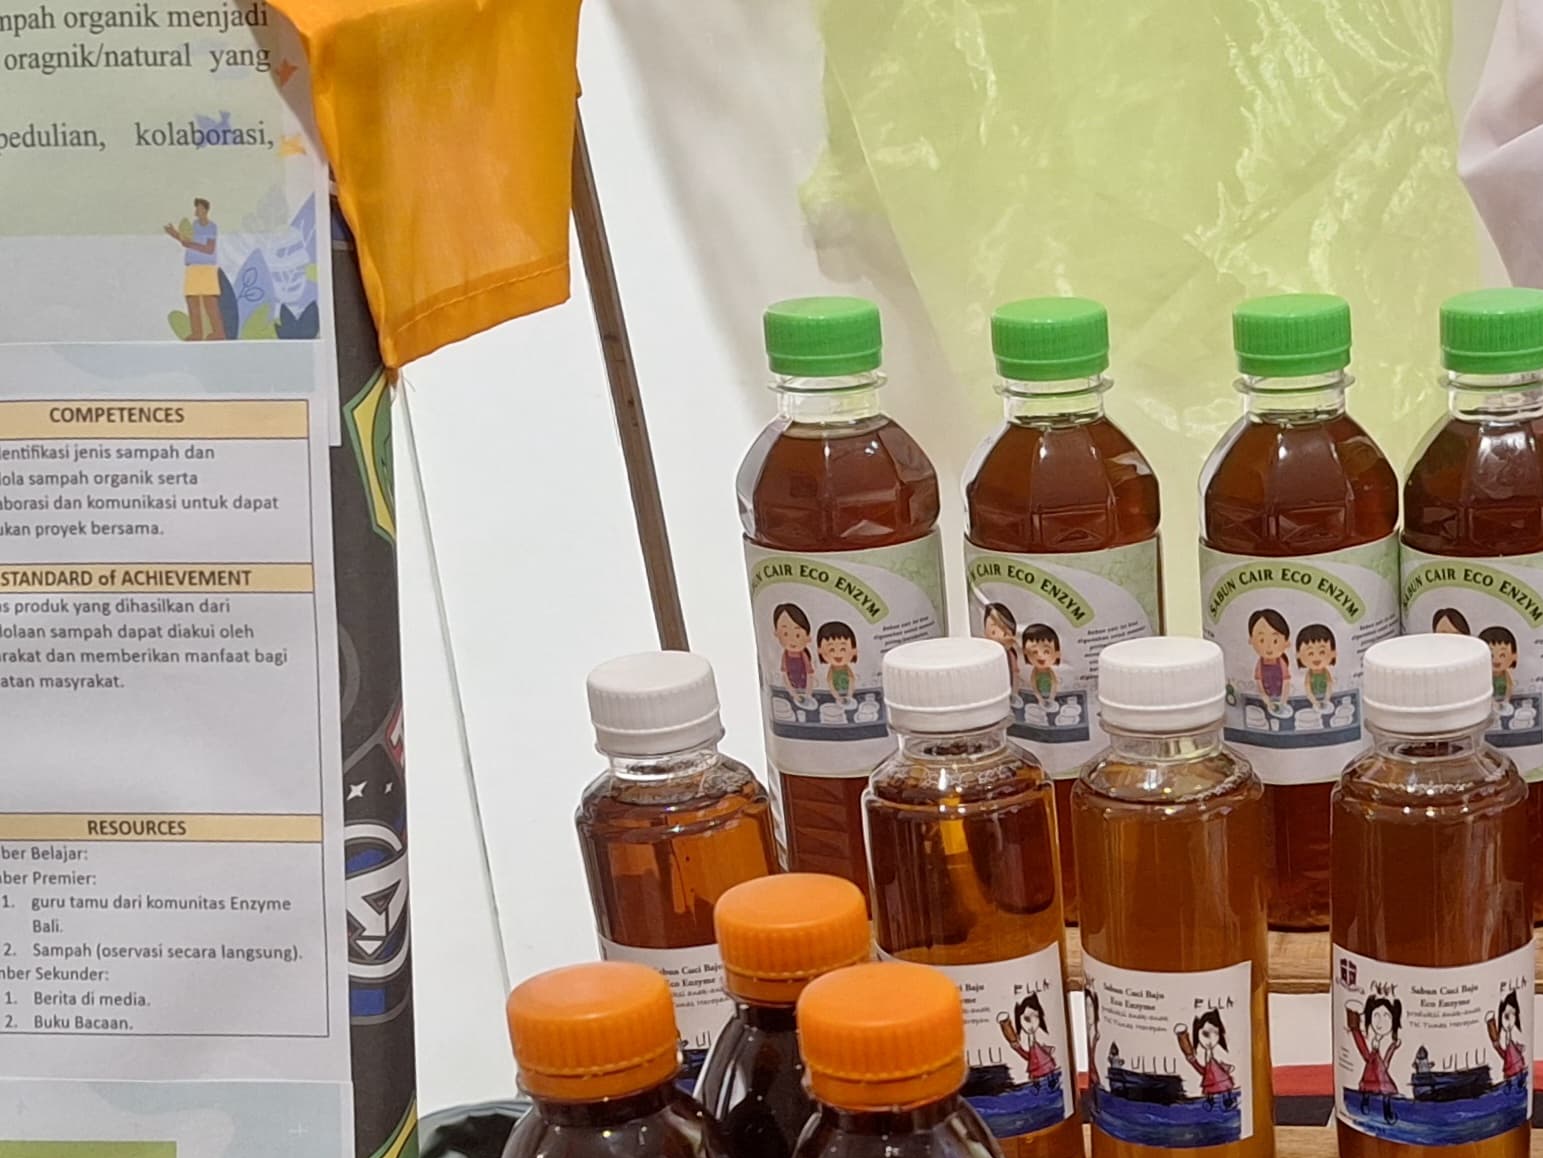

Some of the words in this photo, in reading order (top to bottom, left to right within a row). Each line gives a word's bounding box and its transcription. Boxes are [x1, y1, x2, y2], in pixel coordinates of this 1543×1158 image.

[64, 4, 160, 34] organik
[167, 2, 269, 33] menjadi
[4, 43, 192, 74] oragnik/natural
[210, 48, 271, 73] yang
[135, 121, 275, 150] kolaborasi,
[50, 407, 184, 423] COMPETENCES
[0, 445, 69, 460] entifikasi
[73, 446, 111, 462] jenis
[116, 446, 179, 462] sampah
[184, 446, 215, 460] dan
[29, 471, 88, 488] sampah
[94, 471, 154, 488] organik
[158, 473, 198, 485] serta
[0, 496, 49, 511] borasi
[54, 496, 81, 510] dan
[87, 496, 176, 511] komunikasi
[182, 496, 228, 510] untuk
[233, 496, 278, 513] dapat
[35, 521, 87, 540] proyek
[91, 521, 164, 536] bersama.
[1, 571, 92, 586] STANDARD
[98, 570, 117, 586] of
[121, 570, 252, 586] ACHIEVEMENT
[764, 564, 793, 579] CAIR
[800, 565, 829, 583] ECO
[835, 577, 880, 618] ENZYM
[976, 563, 1001, 578] CAIR
[1007, 565, 1035, 585] ECO
[1040, 578, 1086, 622] ENZYM
[1209, 578, 1237, 618] SABUN
[1239, 569, 1273, 586] CAIR
[1281, 568, 1312, 585] ECO
[1317, 578, 1360, 618] ENZYM
[1425, 568, 1456, 583] CAIR
[1463, 569, 1494, 587] ECO
[1499, 580, 1543, 622] ENZYM
[14, 599, 69, 617] produk
[73, 602, 111, 617] yang
[115, 599, 194, 613] dihasilkan
[199, 598, 230, 612] dari
[50, 625, 112, 642] sampah
[117, 624, 163, 642] dapat
[167, 624, 215, 639] diakui
[220, 624, 254, 639] oleh
[0, 649, 41, 663] rakat
[46, 649, 76, 663] dan
[81, 649, 180, 663] memberikan
[185, 648, 250, 663] manfaat
[255, 649, 288, 666] bagi
[40, 675, 124, 691] masyrakat.
[88, 820, 186, 836] RESOURCES
[31, 847, 88, 864] Belajar:
[0, 871, 28, 885] ber
[33, 872, 96, 886] Premier:
[3, 895, 15, 909] 1.
[31, 897, 65, 912] guru
[70, 897, 108, 909] tamu
[113, 895, 142, 909] dari
[147, 895, 226, 910] komunitas
[230, 897, 292, 914] Enzyme
[32, 919, 63, 933] Bali.
[3, 943, 16, 957] 2.
[33, 943, 91, 961] Sampah
[97, 943, 163, 962] (oservasi
[167, 947, 216, 959] secara
[221, 944, 303, 962] langsung).
[35, 967, 109, 982] Sekunder:
[5, 992, 17, 1005] 1.
[34, 991, 77, 1006] Berita
[81, 991, 95, 1006] di
[99, 992, 150, 1007] media.
[5, 1015, 17, 1029] 2.
[34, 1016, 70, 1030] Buku
[75, 1016, 133, 1030] Bacaan.
